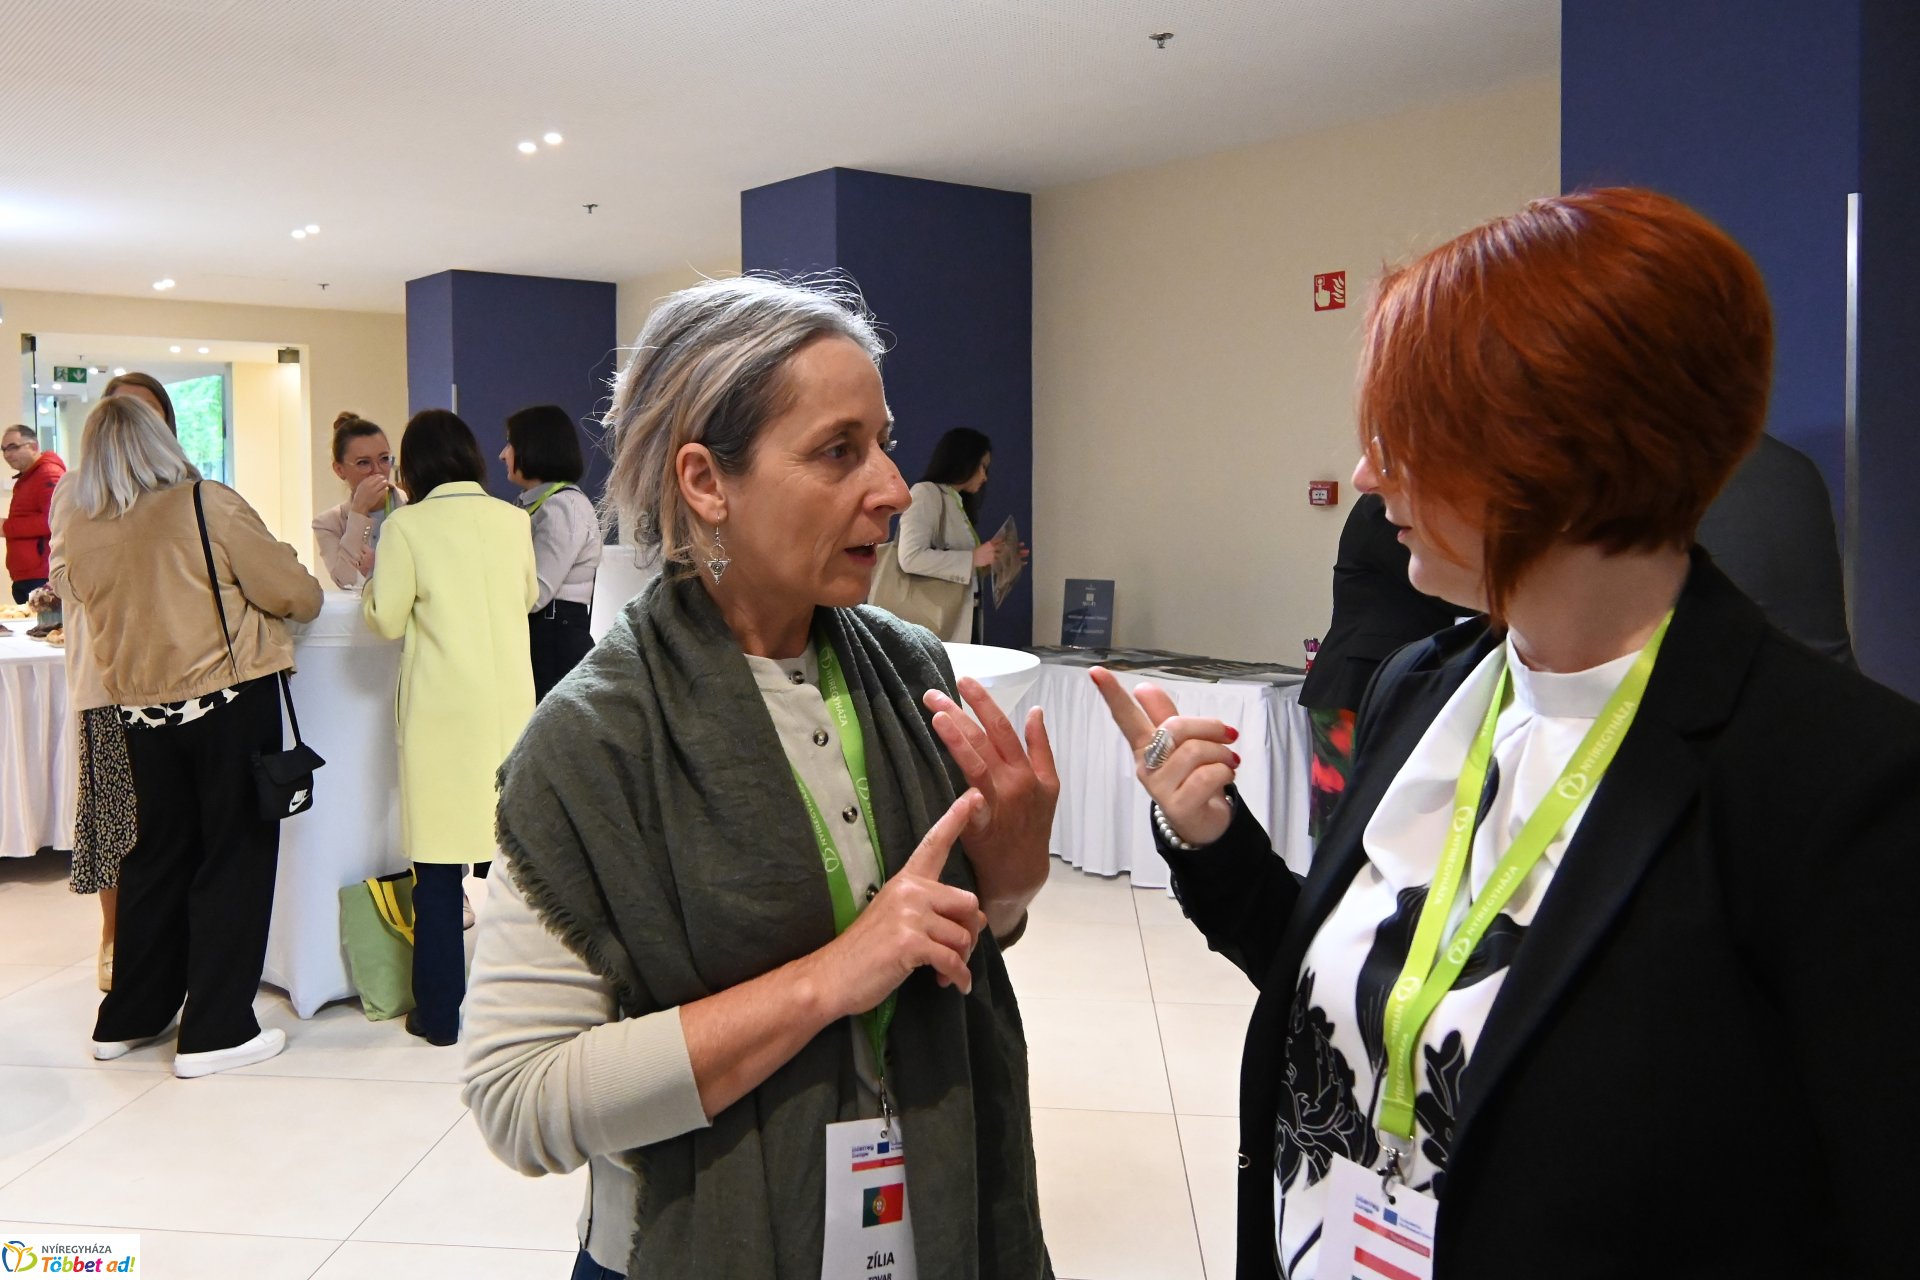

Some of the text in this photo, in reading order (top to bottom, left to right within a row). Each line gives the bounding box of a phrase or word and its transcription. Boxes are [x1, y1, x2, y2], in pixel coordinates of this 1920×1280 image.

[1580, 701, 1636, 772] NYÍREGYHÁZA
[1434, 834, 1462, 905] NYÍREGYHÁZA
[1466, 866, 1519, 936] NYÍREGYHÁZA
[867, 1251, 895, 1270] ZÍLIA
